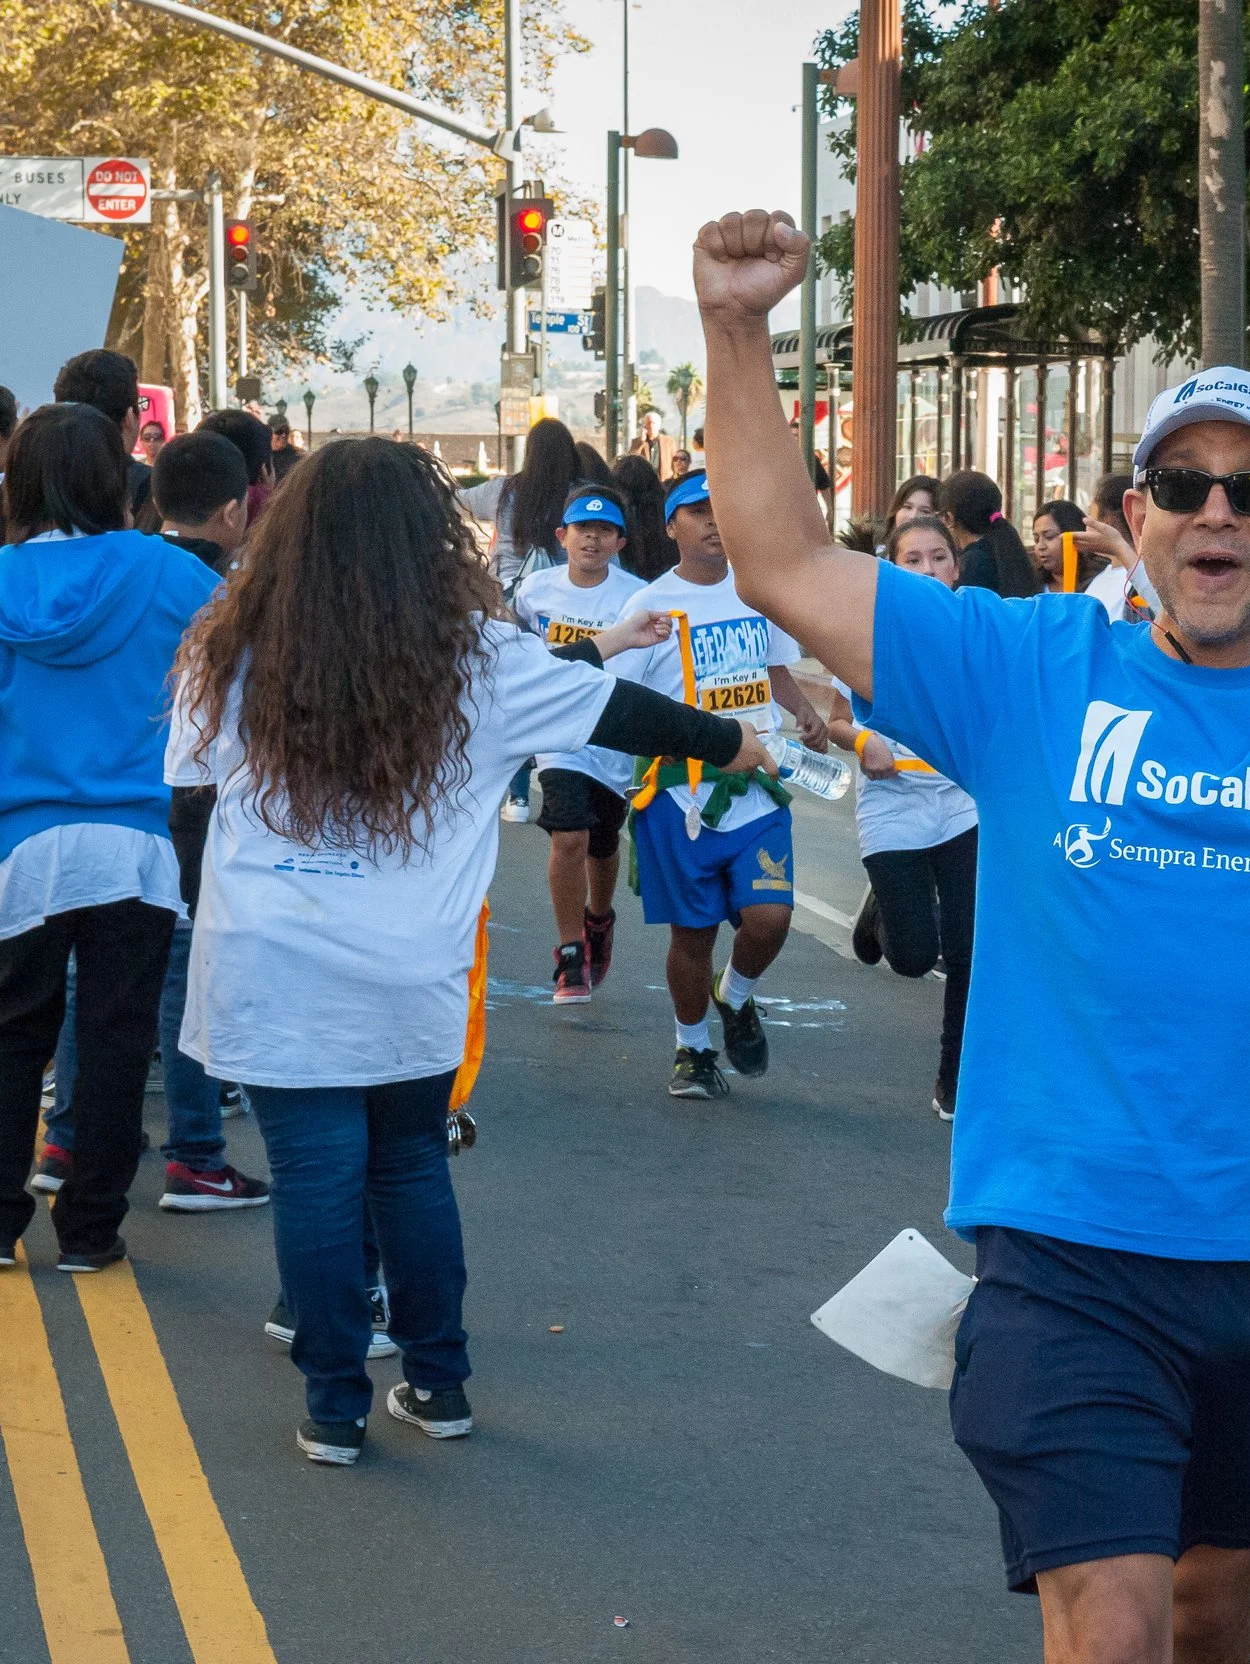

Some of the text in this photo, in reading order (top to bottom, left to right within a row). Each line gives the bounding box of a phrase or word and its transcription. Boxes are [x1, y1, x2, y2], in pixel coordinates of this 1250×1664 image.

[14, 172, 66, 184] BUSES
[96, 171, 138, 183] DO NOT
[98, 199, 136, 211] ENTER
[577, 314, 589, 328] St
[561, 615, 574, 623] I'm
[577, 617, 594, 627] Key
[554, 625, 601, 644] 126
[714, 677, 730, 686] I'm
[732, 673, 749, 683] Key
[708, 682, 766, 711] 12626
[1052, 832, 1062, 848] A
[1109, 838, 1197, 869] Sempra
